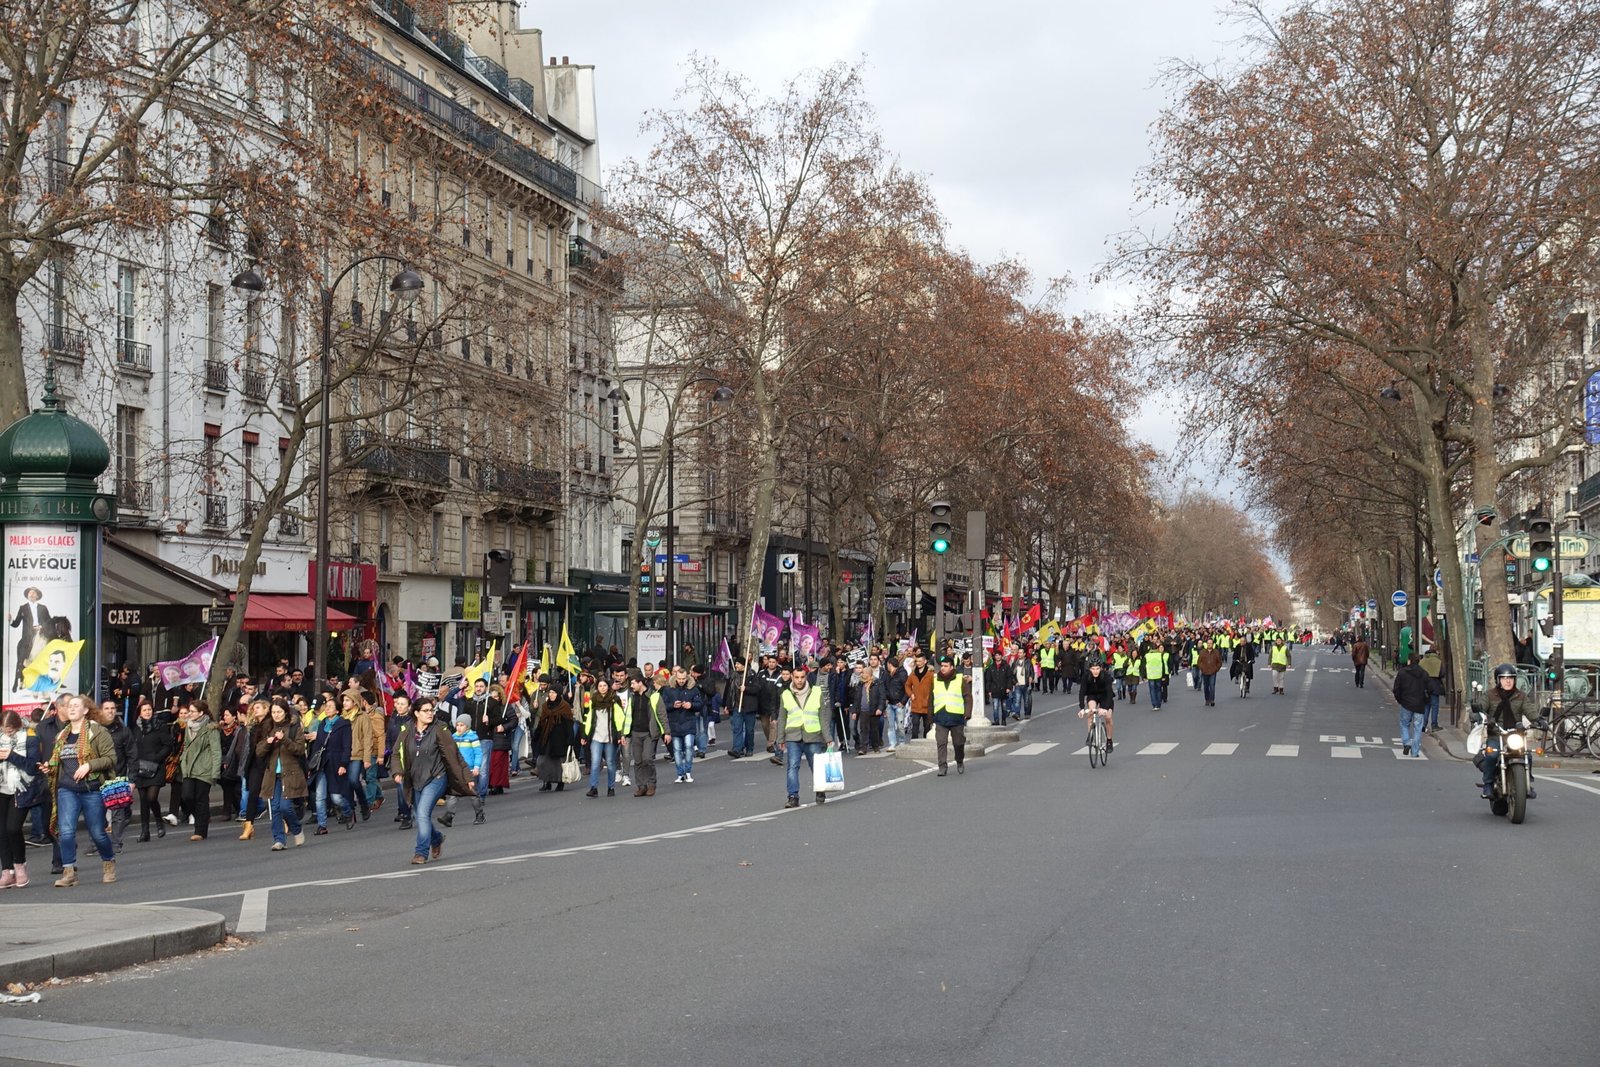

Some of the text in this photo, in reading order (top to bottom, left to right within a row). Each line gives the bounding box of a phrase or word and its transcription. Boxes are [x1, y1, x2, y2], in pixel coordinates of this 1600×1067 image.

[10, 535, 32, 545] PALAIS
[47, 536, 75, 546] GLACES
[8, 554, 77, 570] ALÉVÊQUE
[108, 609, 140, 625] CAFE
